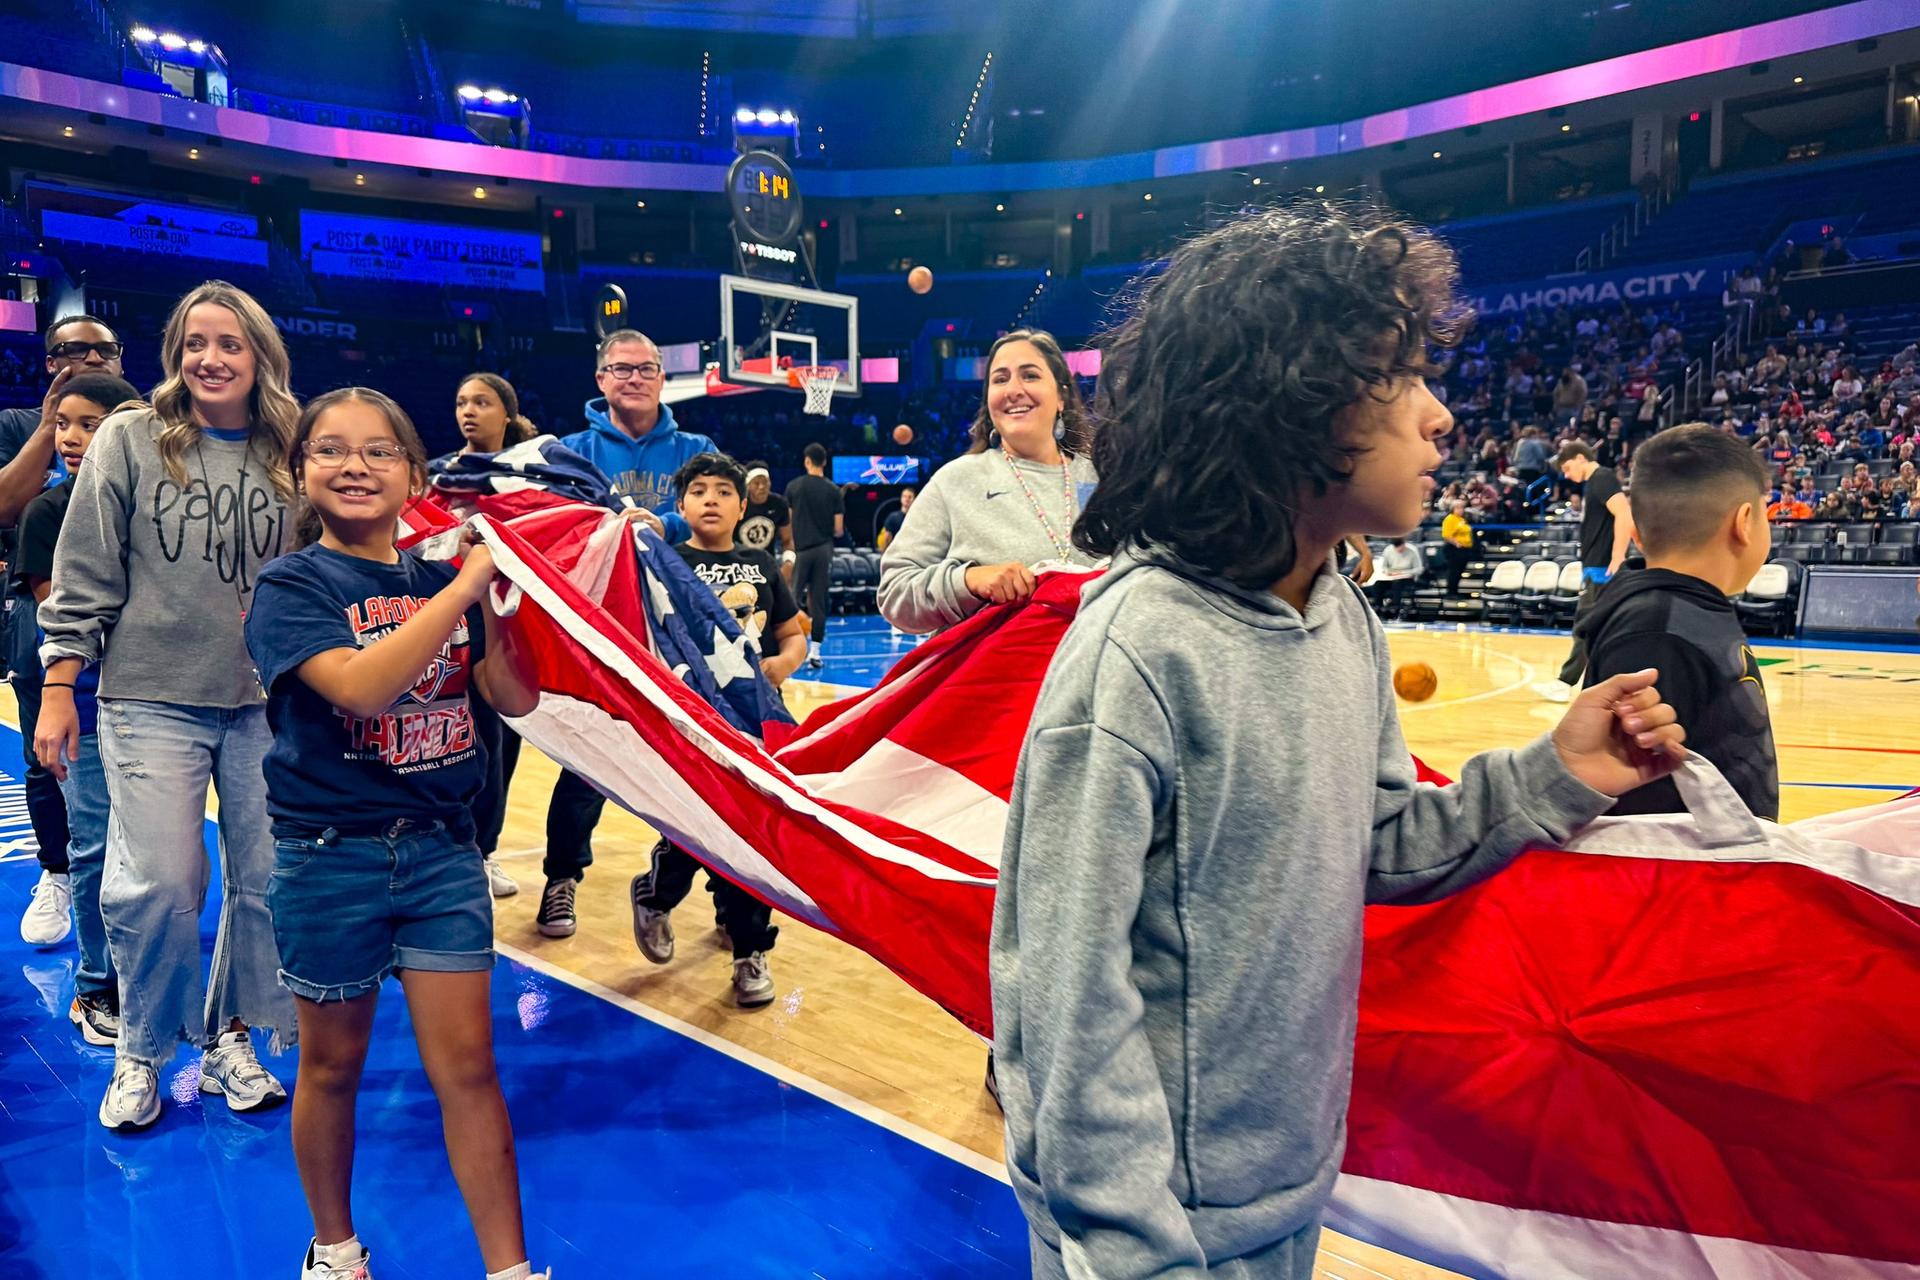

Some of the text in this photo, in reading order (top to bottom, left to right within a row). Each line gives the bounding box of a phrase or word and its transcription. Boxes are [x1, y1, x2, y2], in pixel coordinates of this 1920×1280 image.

[130, 226, 191, 247] POST OAK
[327, 229, 526, 261] POST OAK PARTY TERRACE
[755, 243, 797, 263] TISSOT
[1473, 269, 1707, 314] LAHOMA CITY
[272, 315, 357, 340] NDER
[343, 706, 477, 765] THUNDE
[393, 761, 441, 775] ASKETBALL
[443, 749, 477, 767] ASSOCIATI
